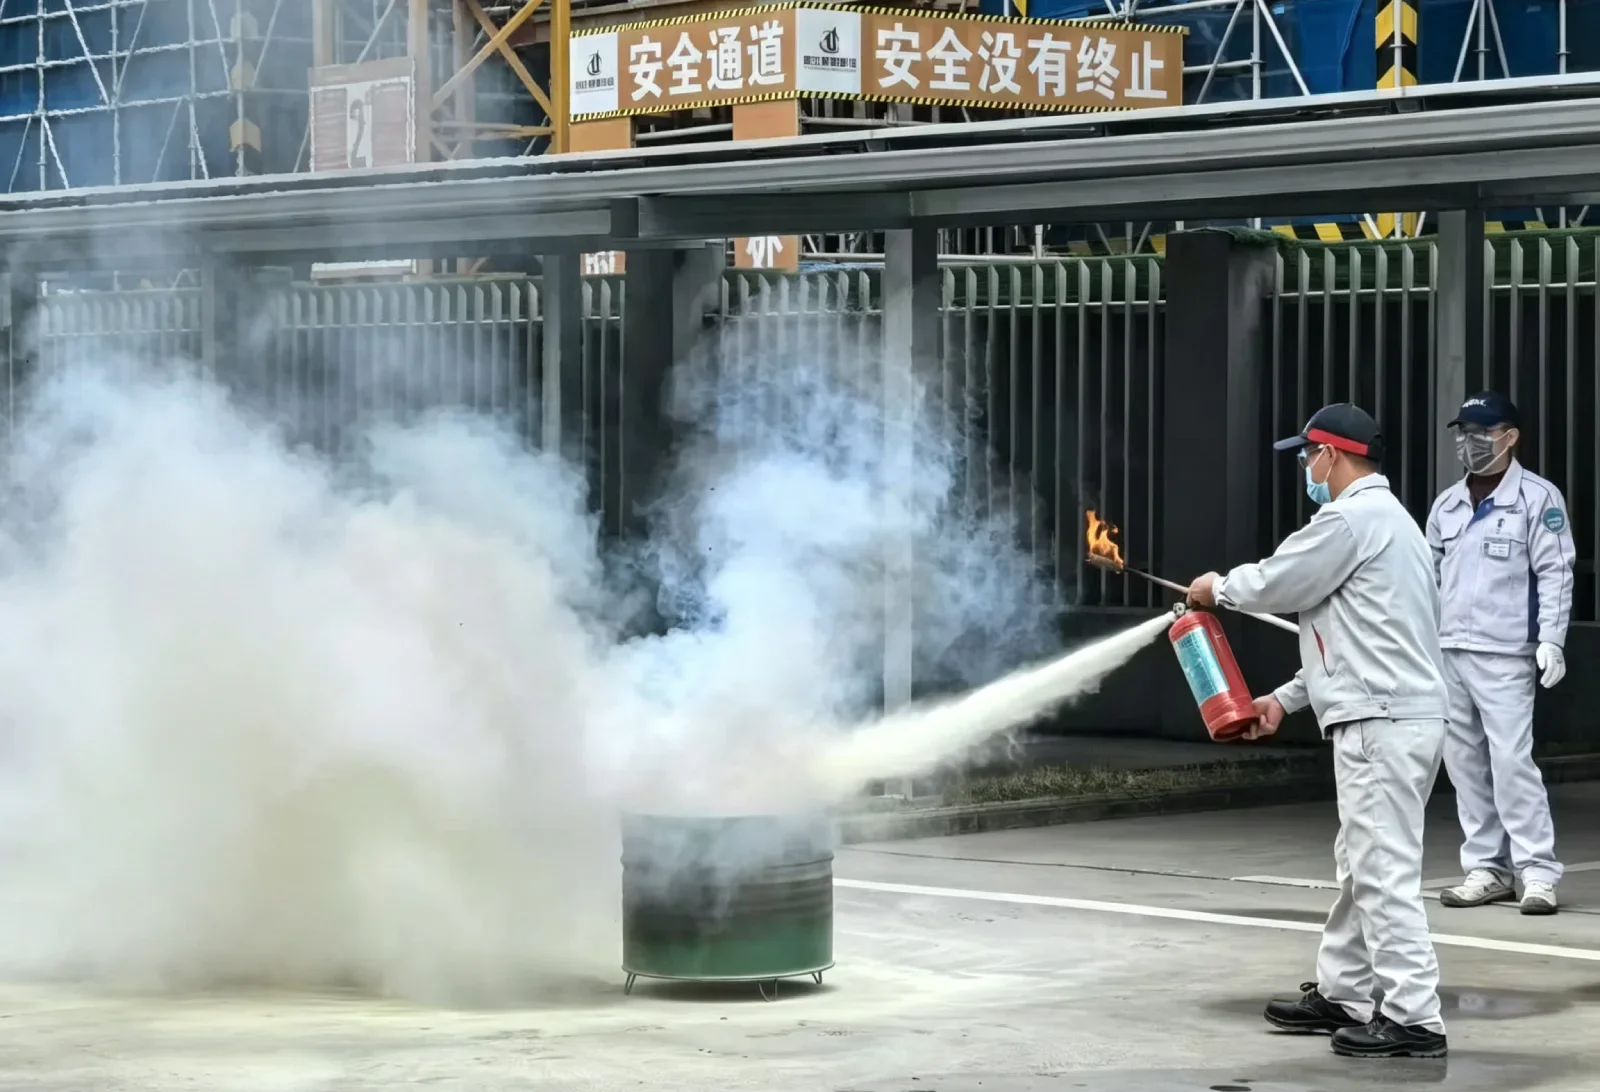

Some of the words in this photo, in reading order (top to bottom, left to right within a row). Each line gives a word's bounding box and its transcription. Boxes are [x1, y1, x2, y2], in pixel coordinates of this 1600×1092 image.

[629, 20, 787, 101] 安全通道
[875, 22, 1168, 100] 安全没有终止
